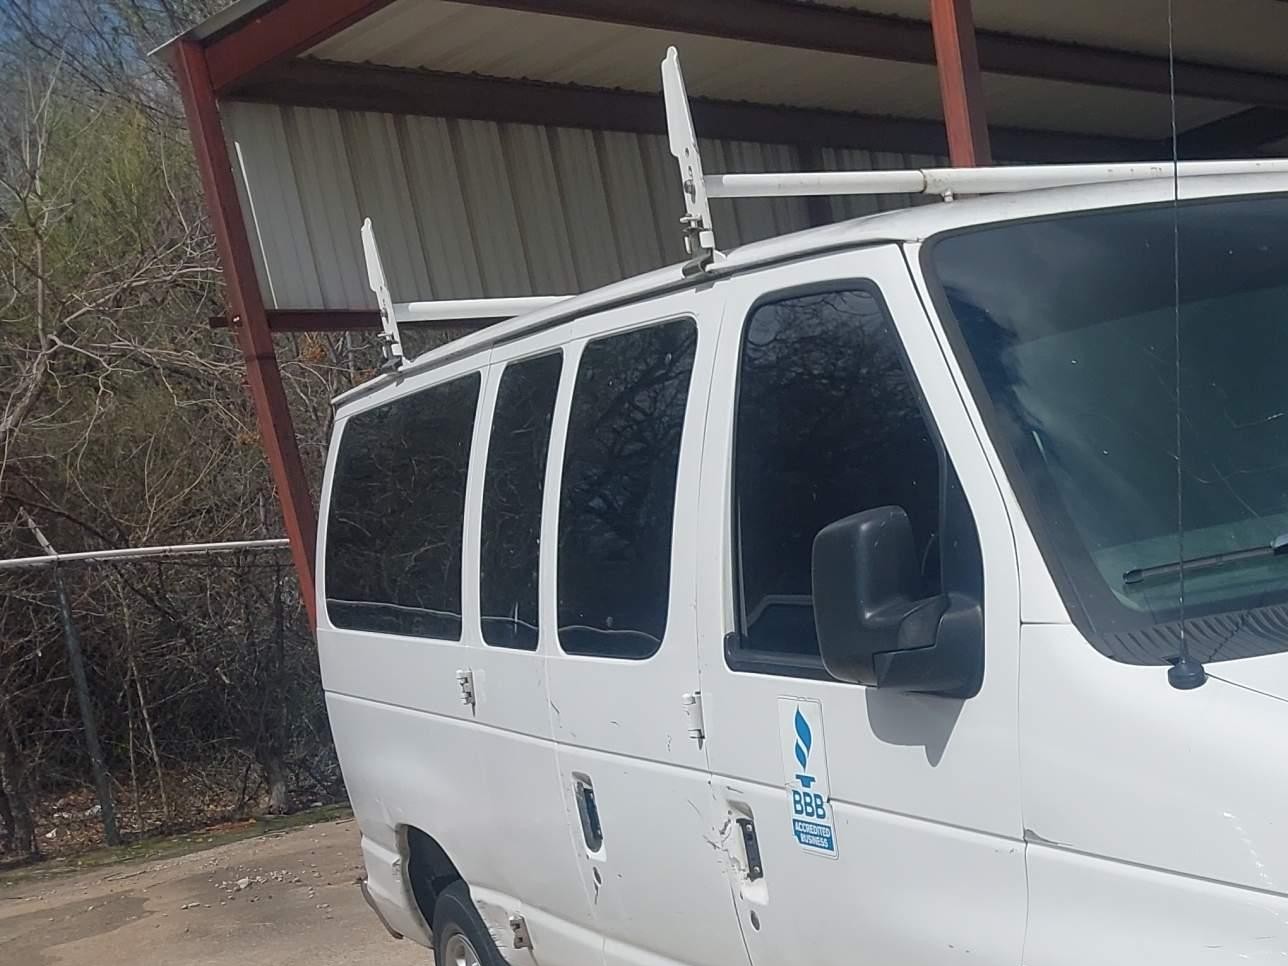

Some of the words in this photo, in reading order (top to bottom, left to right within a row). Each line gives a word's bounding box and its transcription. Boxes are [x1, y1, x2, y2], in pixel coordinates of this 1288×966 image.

[792, 790, 826, 818] BBB
[795, 821, 830, 837] ACCREDITED
[800, 832, 829, 848] BUSINESS
